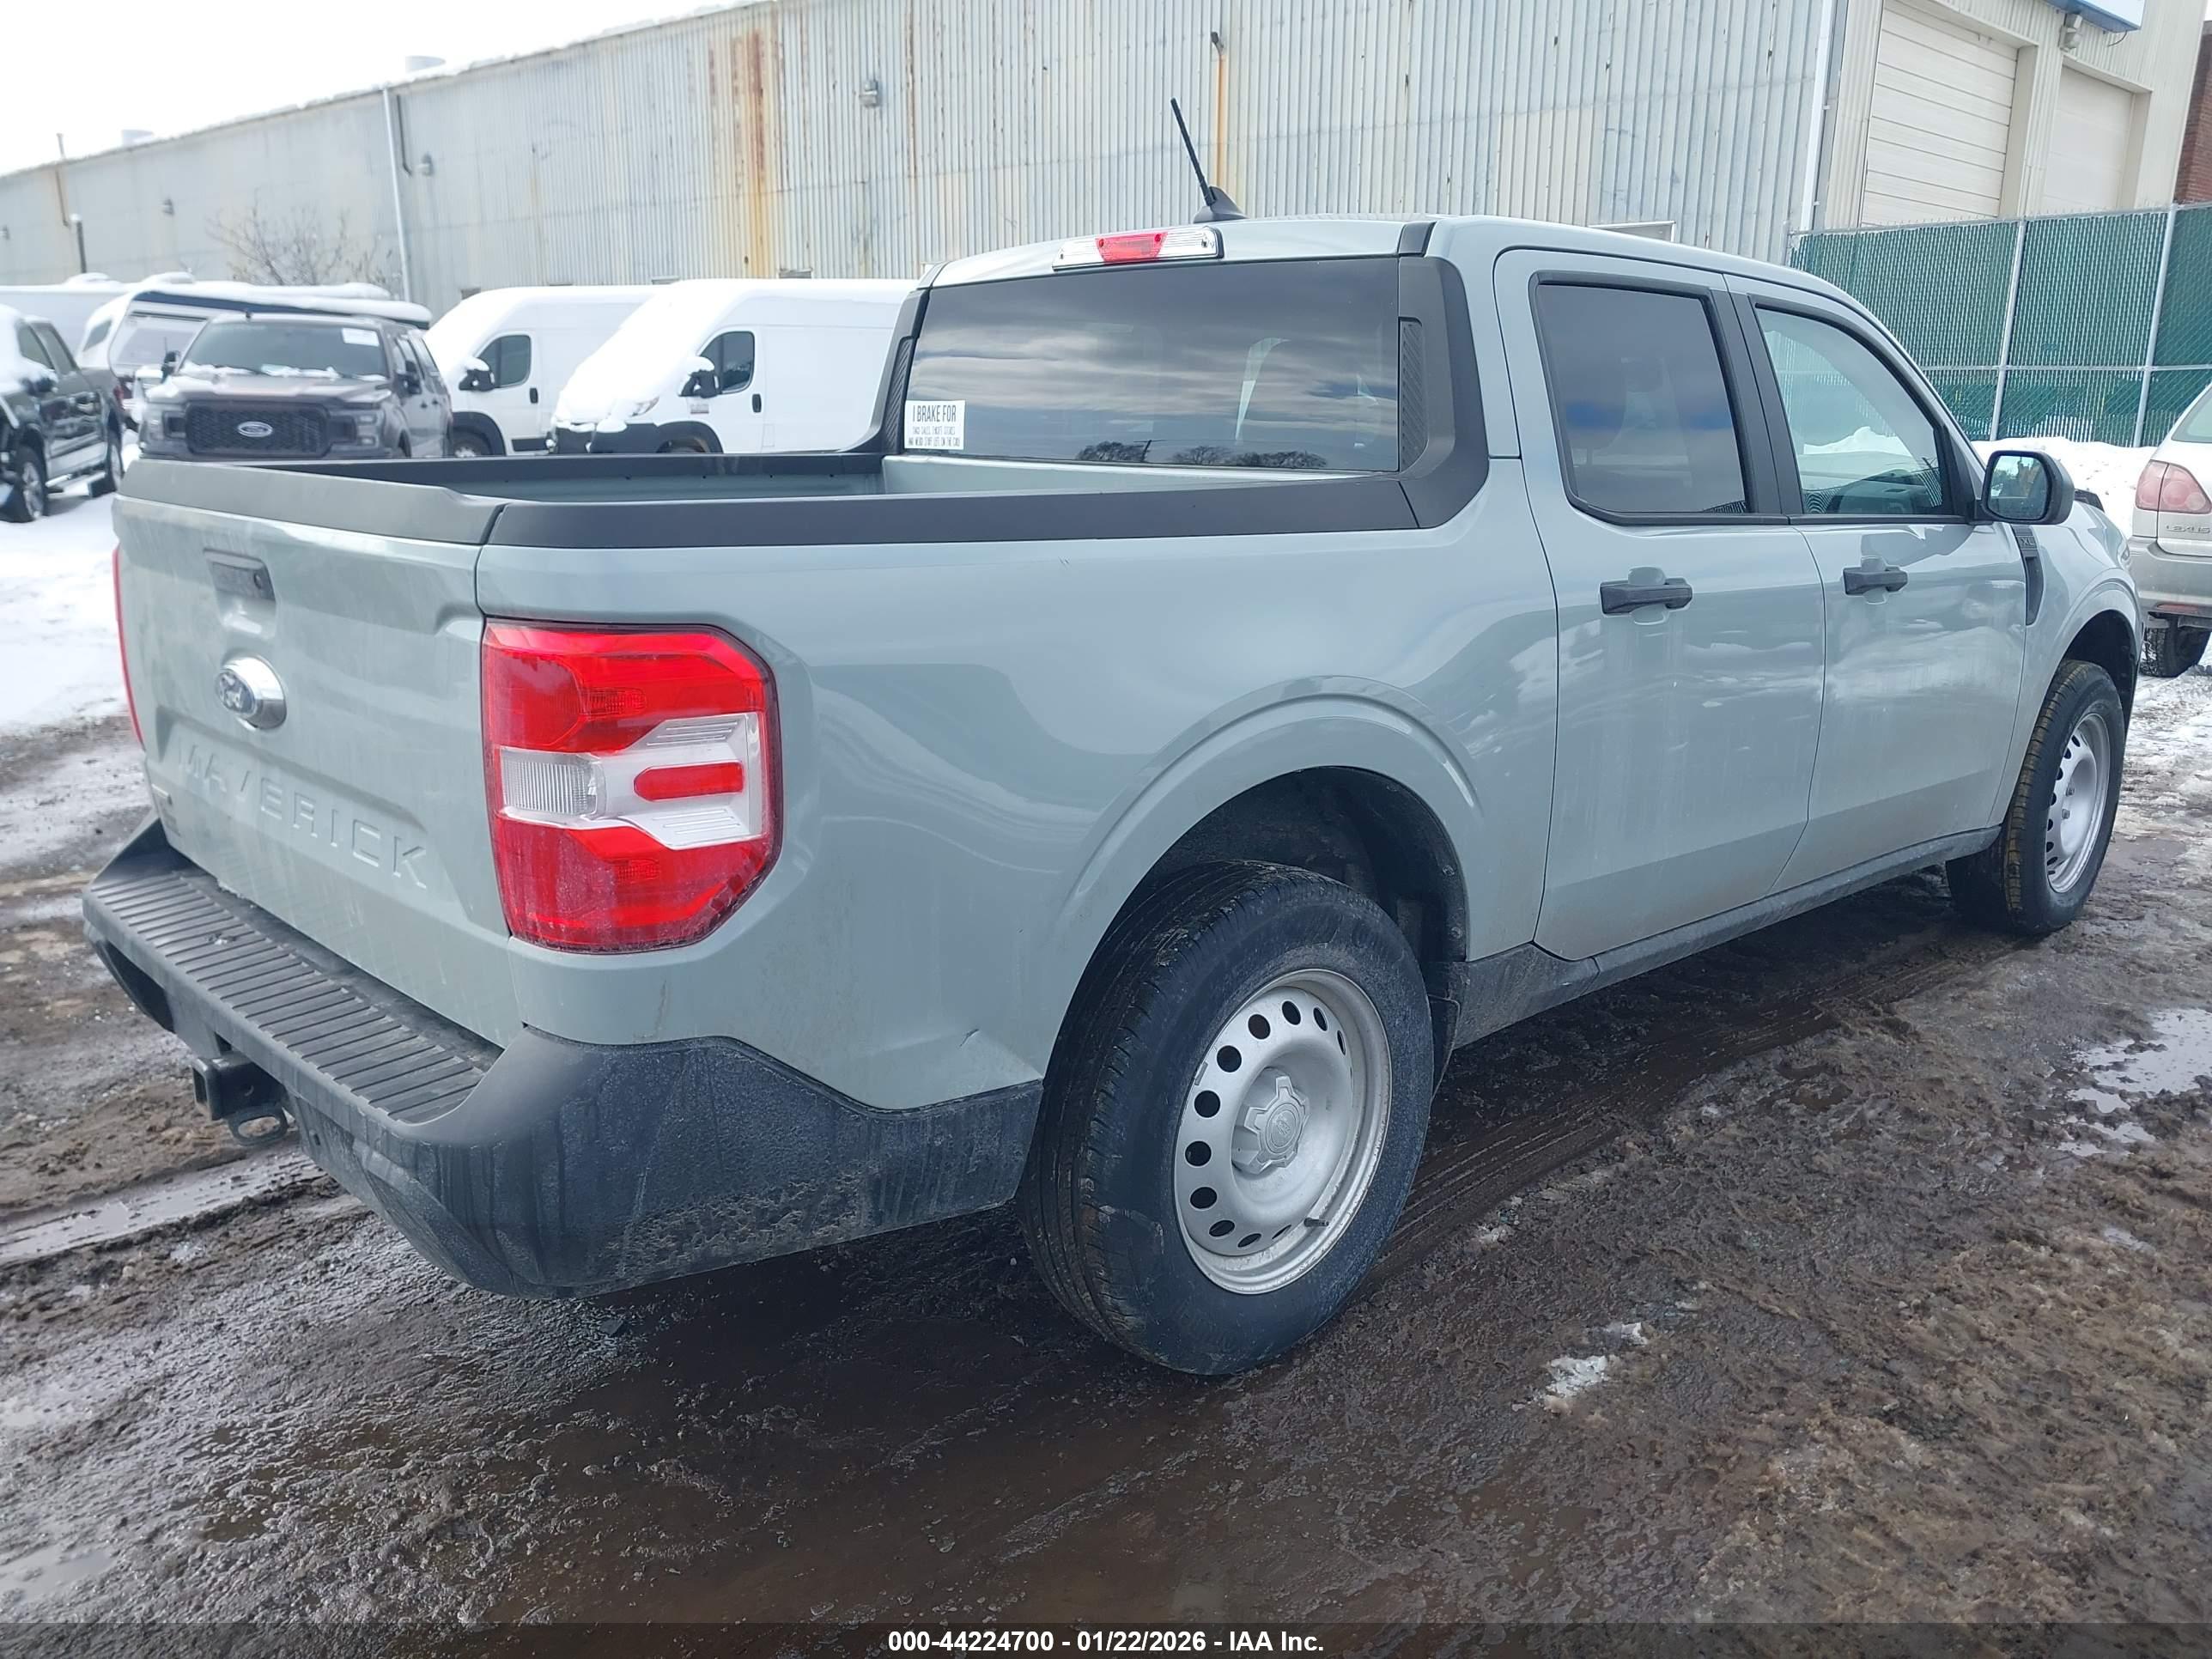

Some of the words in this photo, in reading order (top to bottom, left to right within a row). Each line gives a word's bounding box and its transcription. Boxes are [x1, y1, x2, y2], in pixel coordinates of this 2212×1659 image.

[917, 404, 941, 422] BRAKE
[943, 404, 957, 422] FOR
[2166, 524, 2211, 534] LEXUS
[2021, 537, 2035, 547] XL
